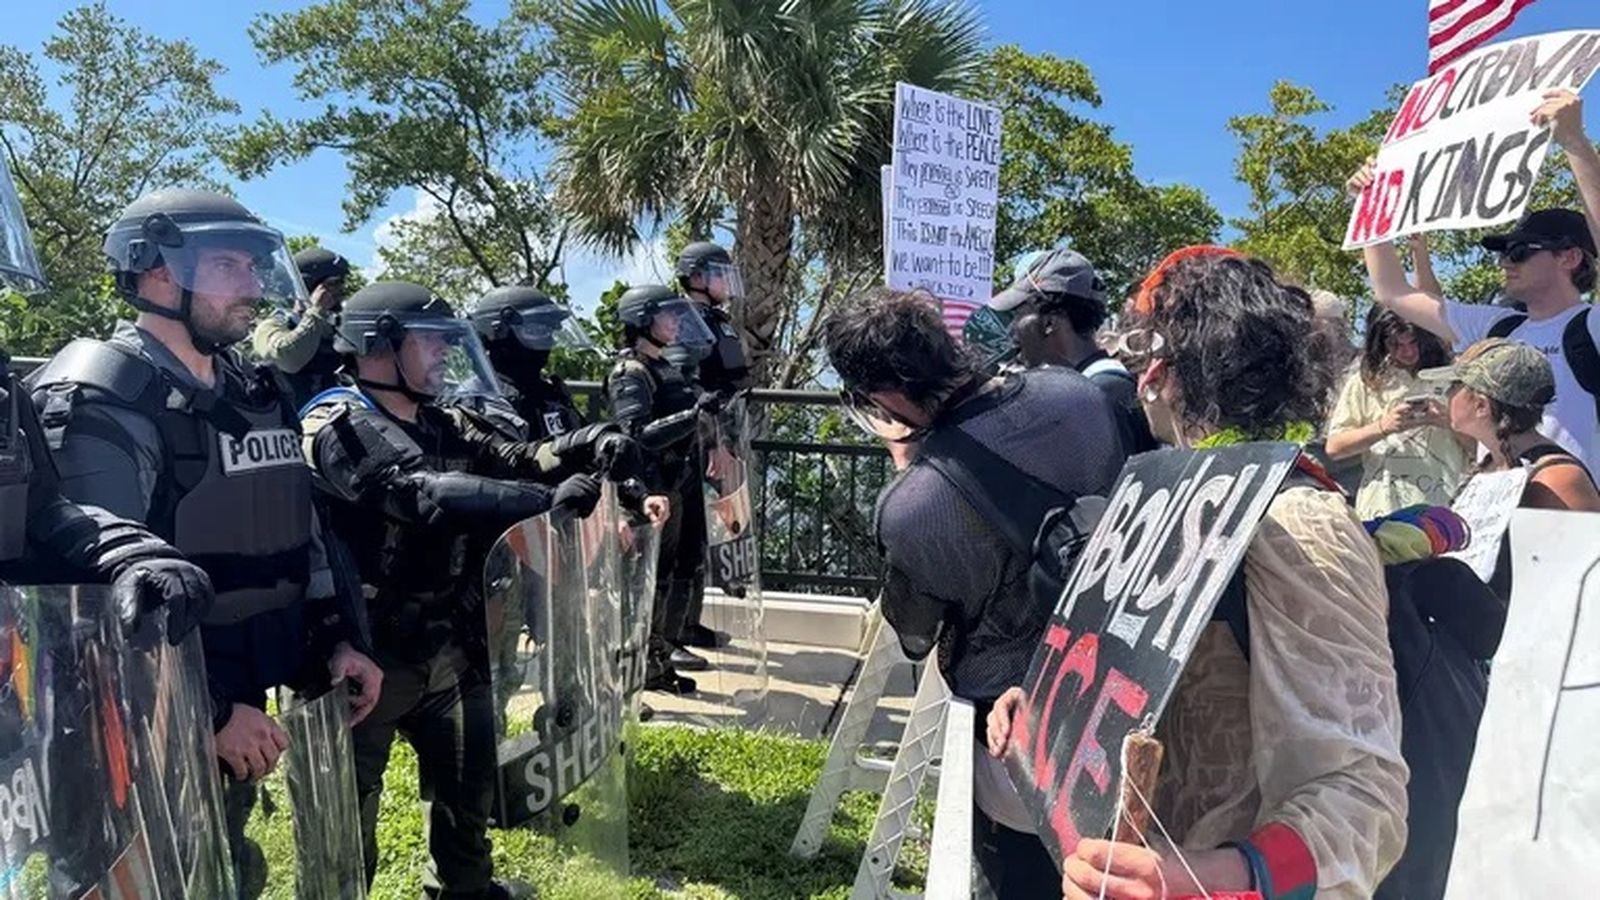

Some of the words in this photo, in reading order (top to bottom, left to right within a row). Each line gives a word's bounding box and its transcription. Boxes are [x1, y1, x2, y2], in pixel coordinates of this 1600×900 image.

[901, 89, 931, 124] Where
[935, 99, 945, 123] is
[946, 101, 965, 131] the
[1383, 66, 1457, 144] NO
[898, 123, 929, 152] Where
[932, 128, 942, 154] is
[1351, 169, 1405, 242] NO
[1396, 126, 1551, 232] KINGS
[892, 216, 918, 243] This
[946, 251, 961, 276] to
[1053, 455, 1289, 663] ABOLISH
